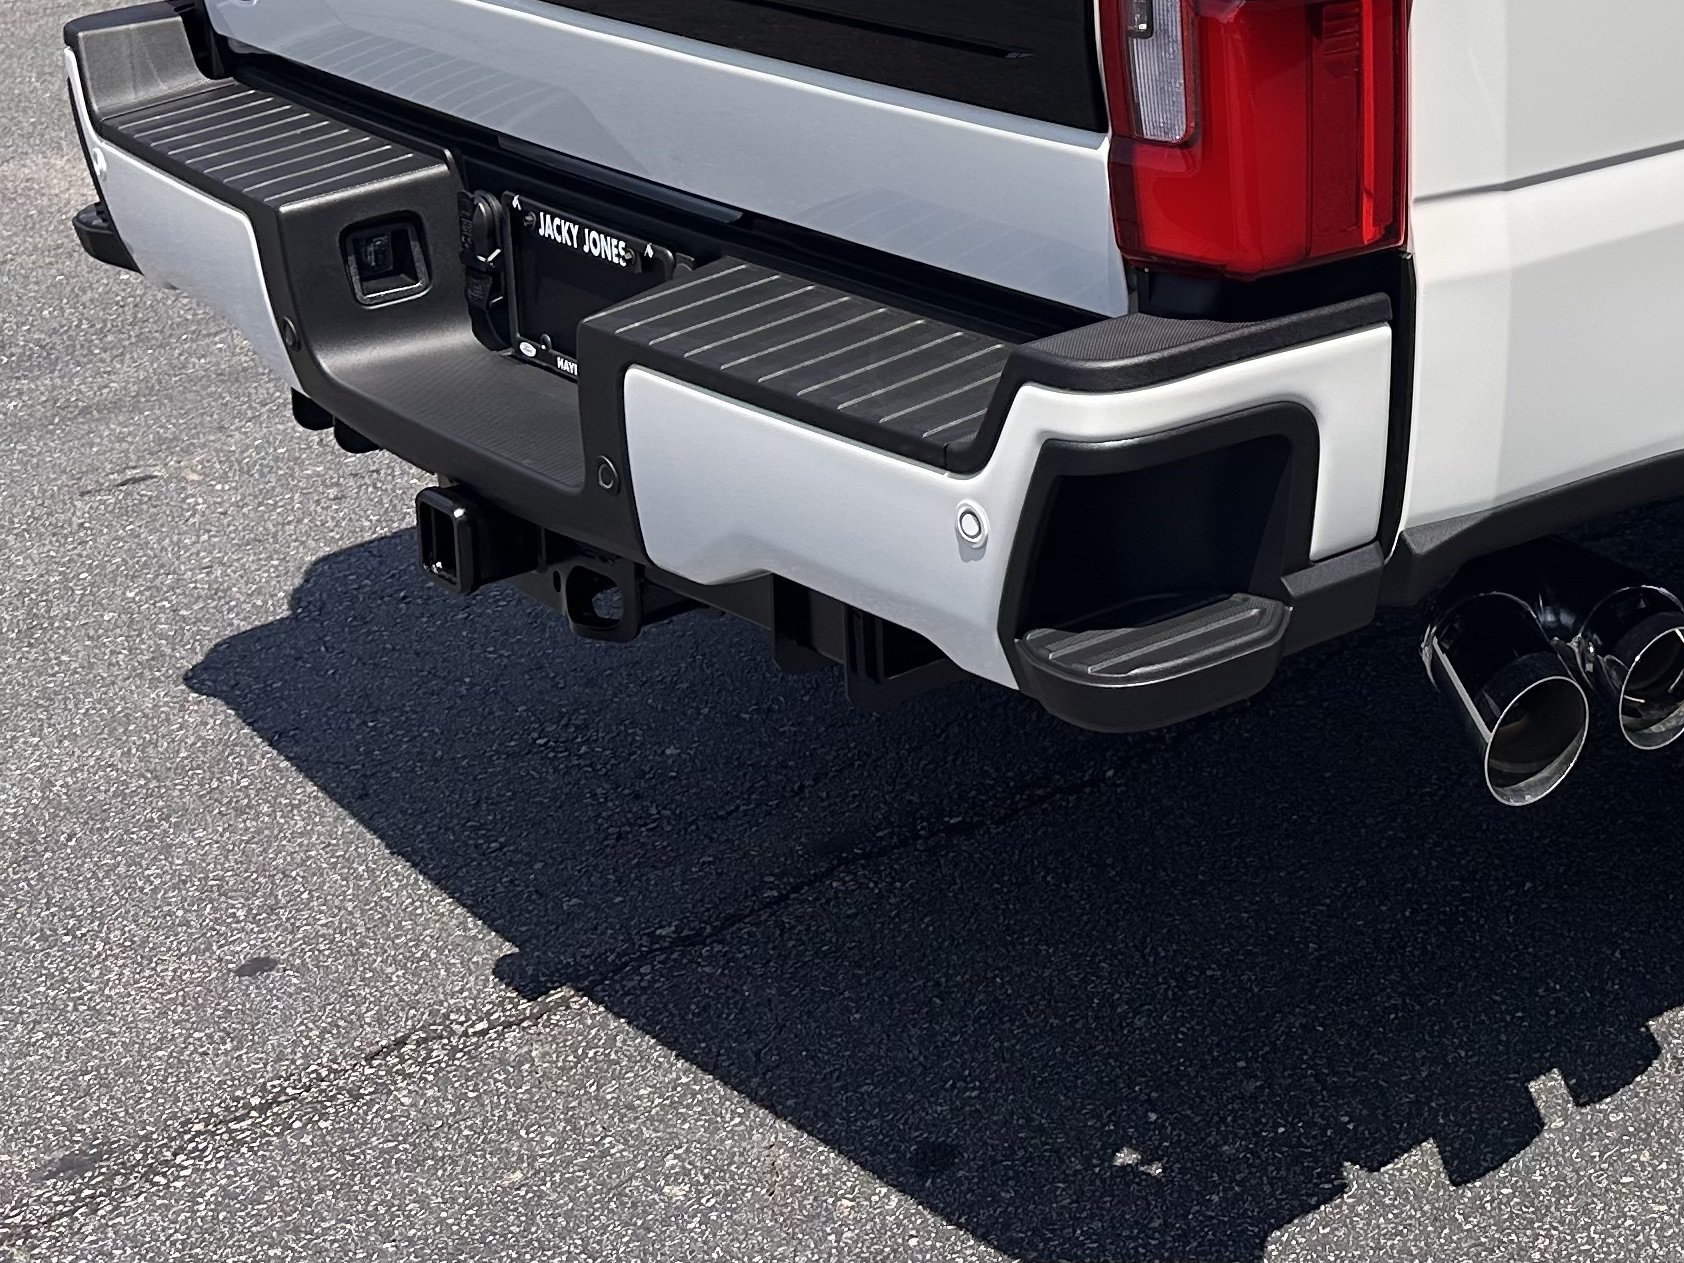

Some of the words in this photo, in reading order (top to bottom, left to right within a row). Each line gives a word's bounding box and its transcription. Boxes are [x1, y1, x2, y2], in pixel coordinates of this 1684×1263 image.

[538, 211, 579, 248] JACKY
[582, 229, 627, 267] JONES
[556, 356, 578, 376] HAY
